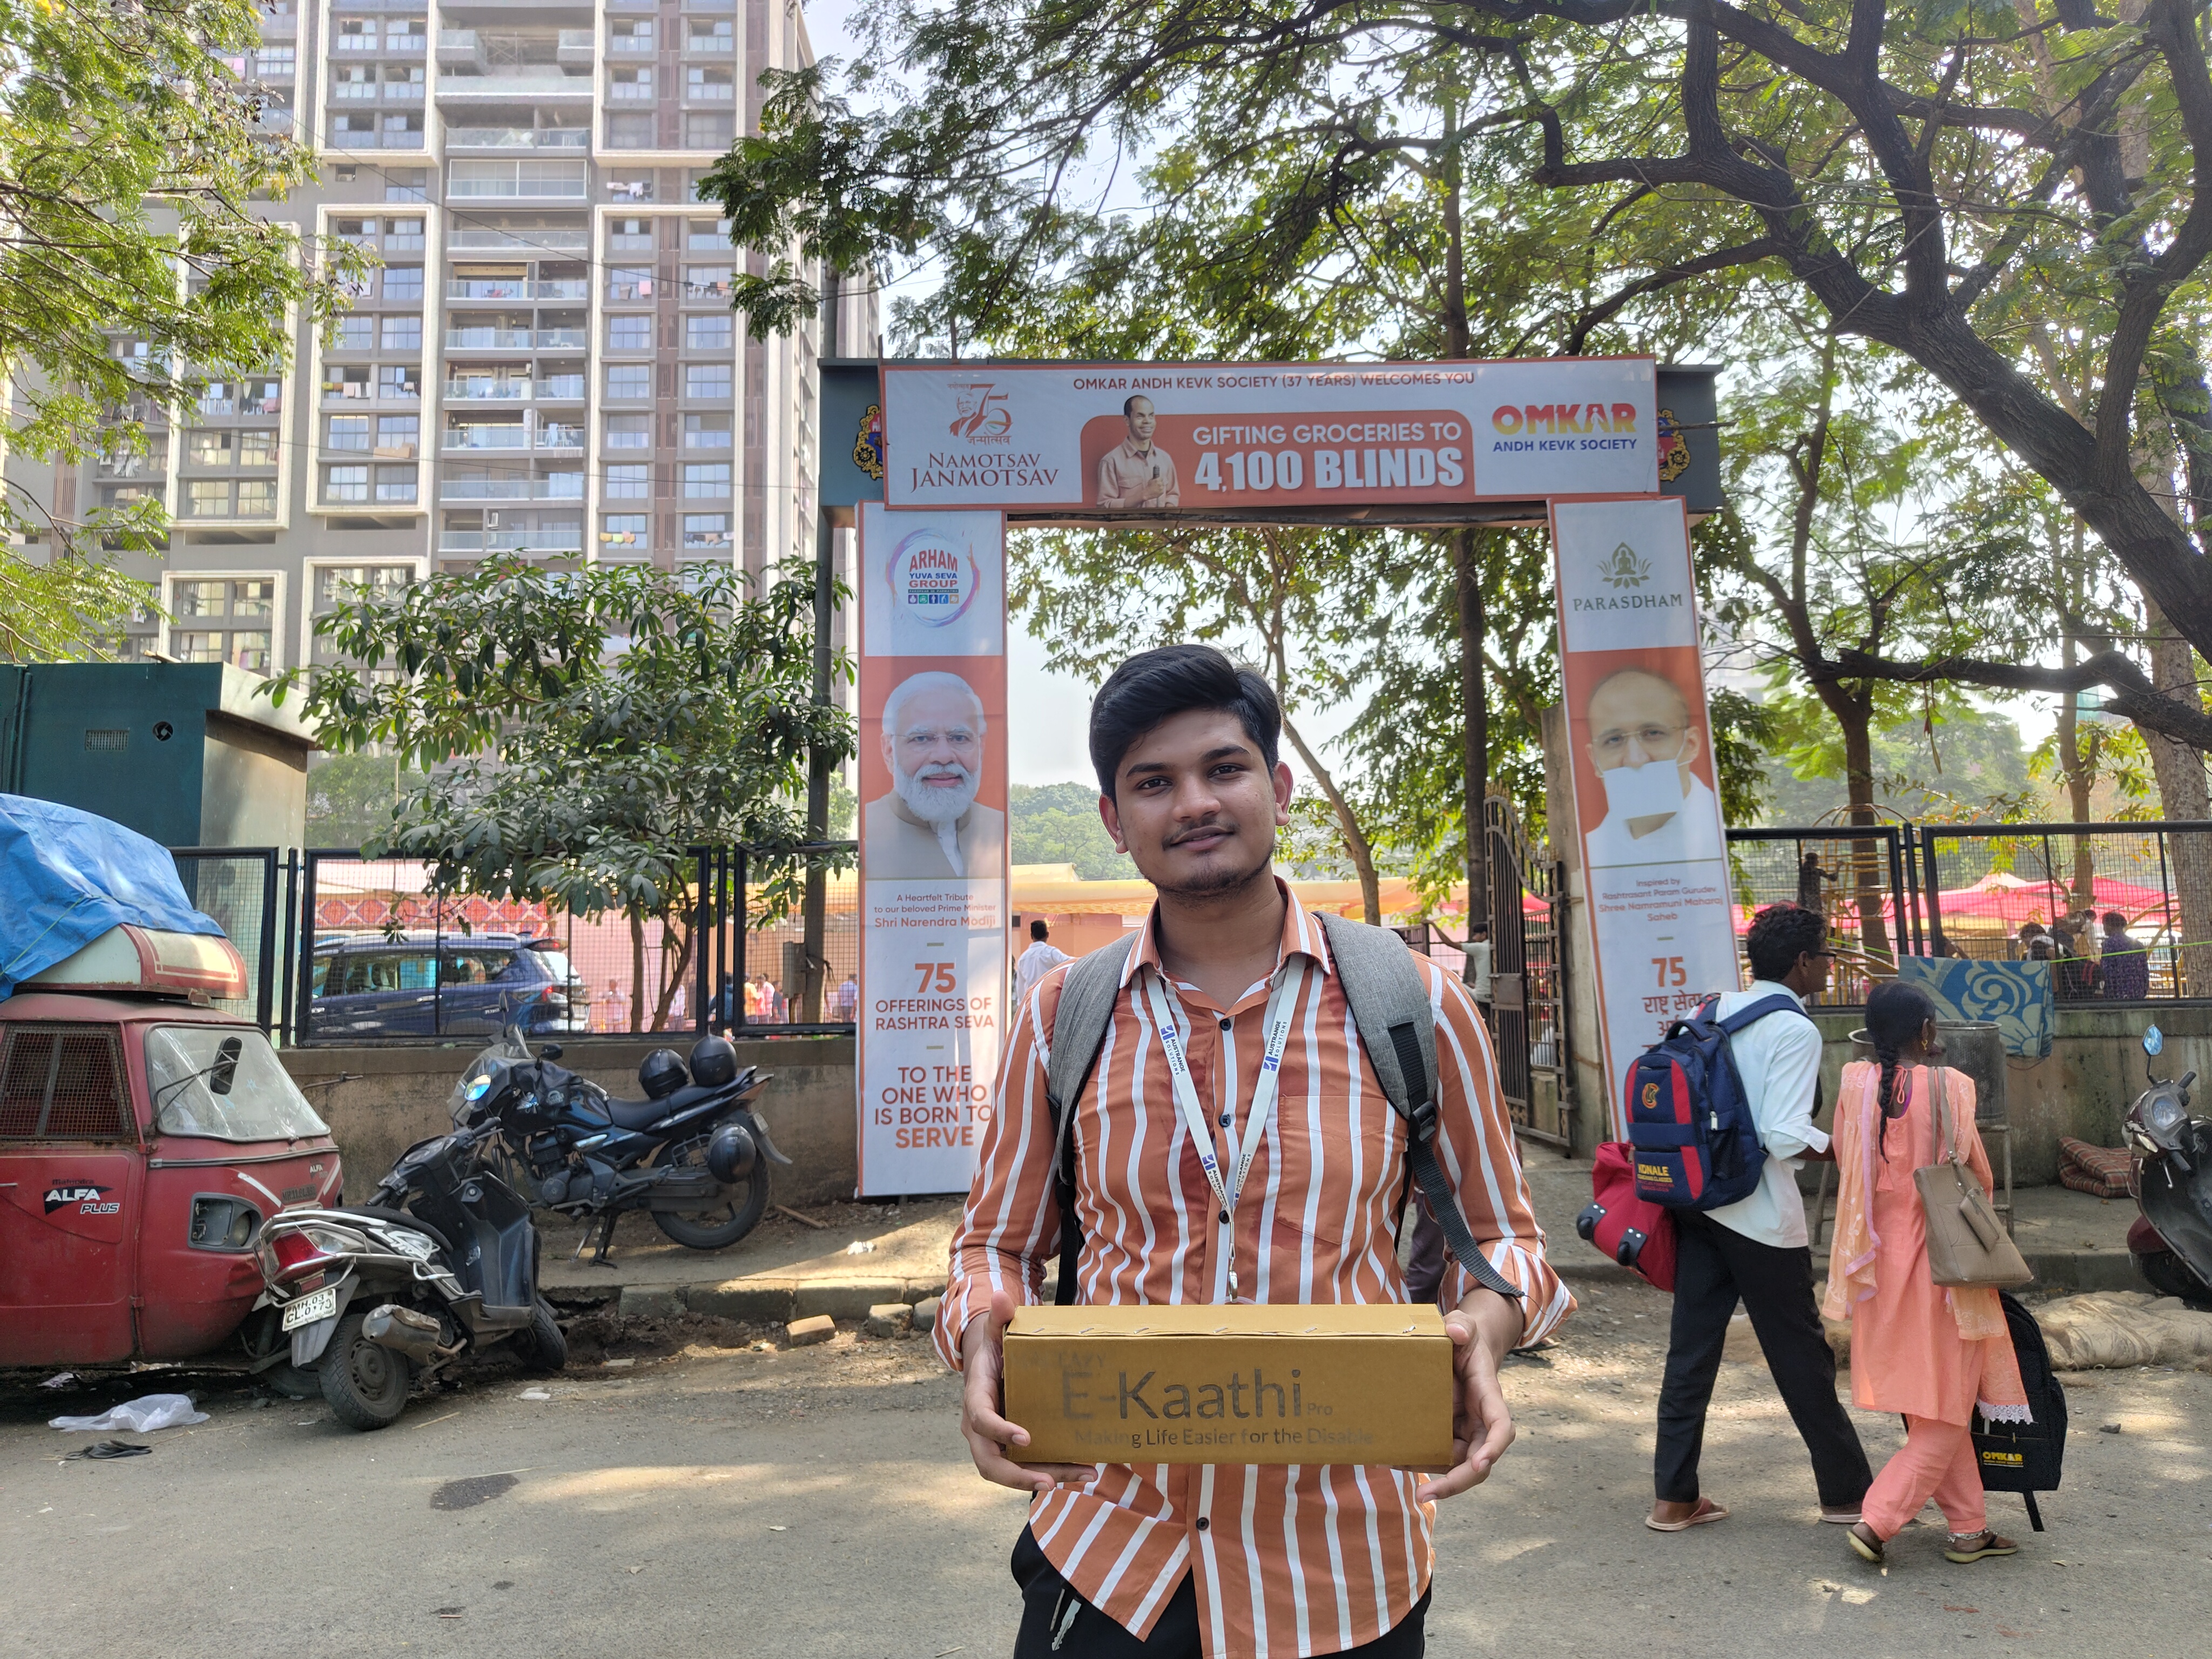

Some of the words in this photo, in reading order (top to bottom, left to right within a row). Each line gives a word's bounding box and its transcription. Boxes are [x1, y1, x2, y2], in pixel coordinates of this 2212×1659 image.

[1074, 378, 1127, 389] OMKAR
[1132, 377, 1172, 389] ANDH
[1177, 377, 1212, 389] KEVK
[1217, 376, 1277, 388] SOCIETY
[1282, 375, 1301, 388] (37
[1306, 374, 1356, 388] YEARS)
[1360, 373, 1441, 386] WELCOMES
[1446, 373, 1474, 385] YOU
[1492, 403, 1636, 435] OMKAR
[1193, 425, 1287, 446] GIFTING
[1293, 422, 1425, 443] GROCERIES
[1430, 422, 1462, 441] TO
[1493, 441, 1534, 452] ANDH
[1539, 440, 1575, 451] KEVK
[1580, 439, 1637, 450] SOCIETY
[929, 453, 1041, 468] NAMOTSAV
[1195, 450, 1303, 492] 4,100
[1314, 447, 1464, 488] BLINDS
[910, 468, 1060, 494] JANMOTSAV
[909, 549, 958, 572] ARHAM
[1573, 594, 1683, 611] PARASDHAM
[1636, 879, 1668, 887] Inspired
[1670, 878, 1680, 886] by
[905, 894, 942, 902] Heartfelt
[945, 893, 974, 901] Tribute
[1602, 891, 1651, 900] Rashtrasant
[1682, 886, 1716, 894] Gurudev
[1599, 903, 1625, 912] Shree
[1628, 899, 1682, 910] Namramuni
[1684, 896, 1723, 907] Maharaj
[874, 917, 898, 928] Shri
[901, 917, 957, 927] Narendra
[960, 915, 995, 928] Modiji
[1647, 912, 1678, 921] Saheb
[914, 962, 956, 994] 75
[1651, 956, 1687, 987] 75
[875, 999, 965, 1013] OFFERINGS
[970, 997, 992, 1010] OF
[1642, 996, 1669, 1015] राष्ट्र
[875, 1016, 949, 1031] RASHTRA
[954, 1015, 995, 1029] SEVA
[1268, 1020, 1281, 1055] AUSTRANGE
[1274, 1021, 1287, 1057] SOLUTIONS
[1165, 1040, 1179, 1075] SOLUTIONS
[1171, 1038, 1185, 1073] AUSTRANGE
[898, 1067, 927, 1083] TO
[933, 1065, 972, 1082] THE
[882, 1087, 926, 1104] ONE
[933, 1084, 987, 1103] WHO
[875, 1108, 893, 1125] IS
[900, 1107, 959, 1125] BORN
[966, 1105, 992, 1122] TO
[895, 1126, 974, 1149] SERVE
[309, 1164, 323, 1173] ALFA
[45, 1189, 101, 1202] ALFA
[80, 1203, 120, 1215] PLUS
[1307, 1402, 1333, 1415] Pro
[1147, 1428, 1178, 1445] Life
[1183, 1428, 1236, 1445] Easier
[1241, 1428, 1268, 1445] for
[1273, 1428, 1303, 1444] the
[1982, 1452, 2023, 1462] OMKAR
